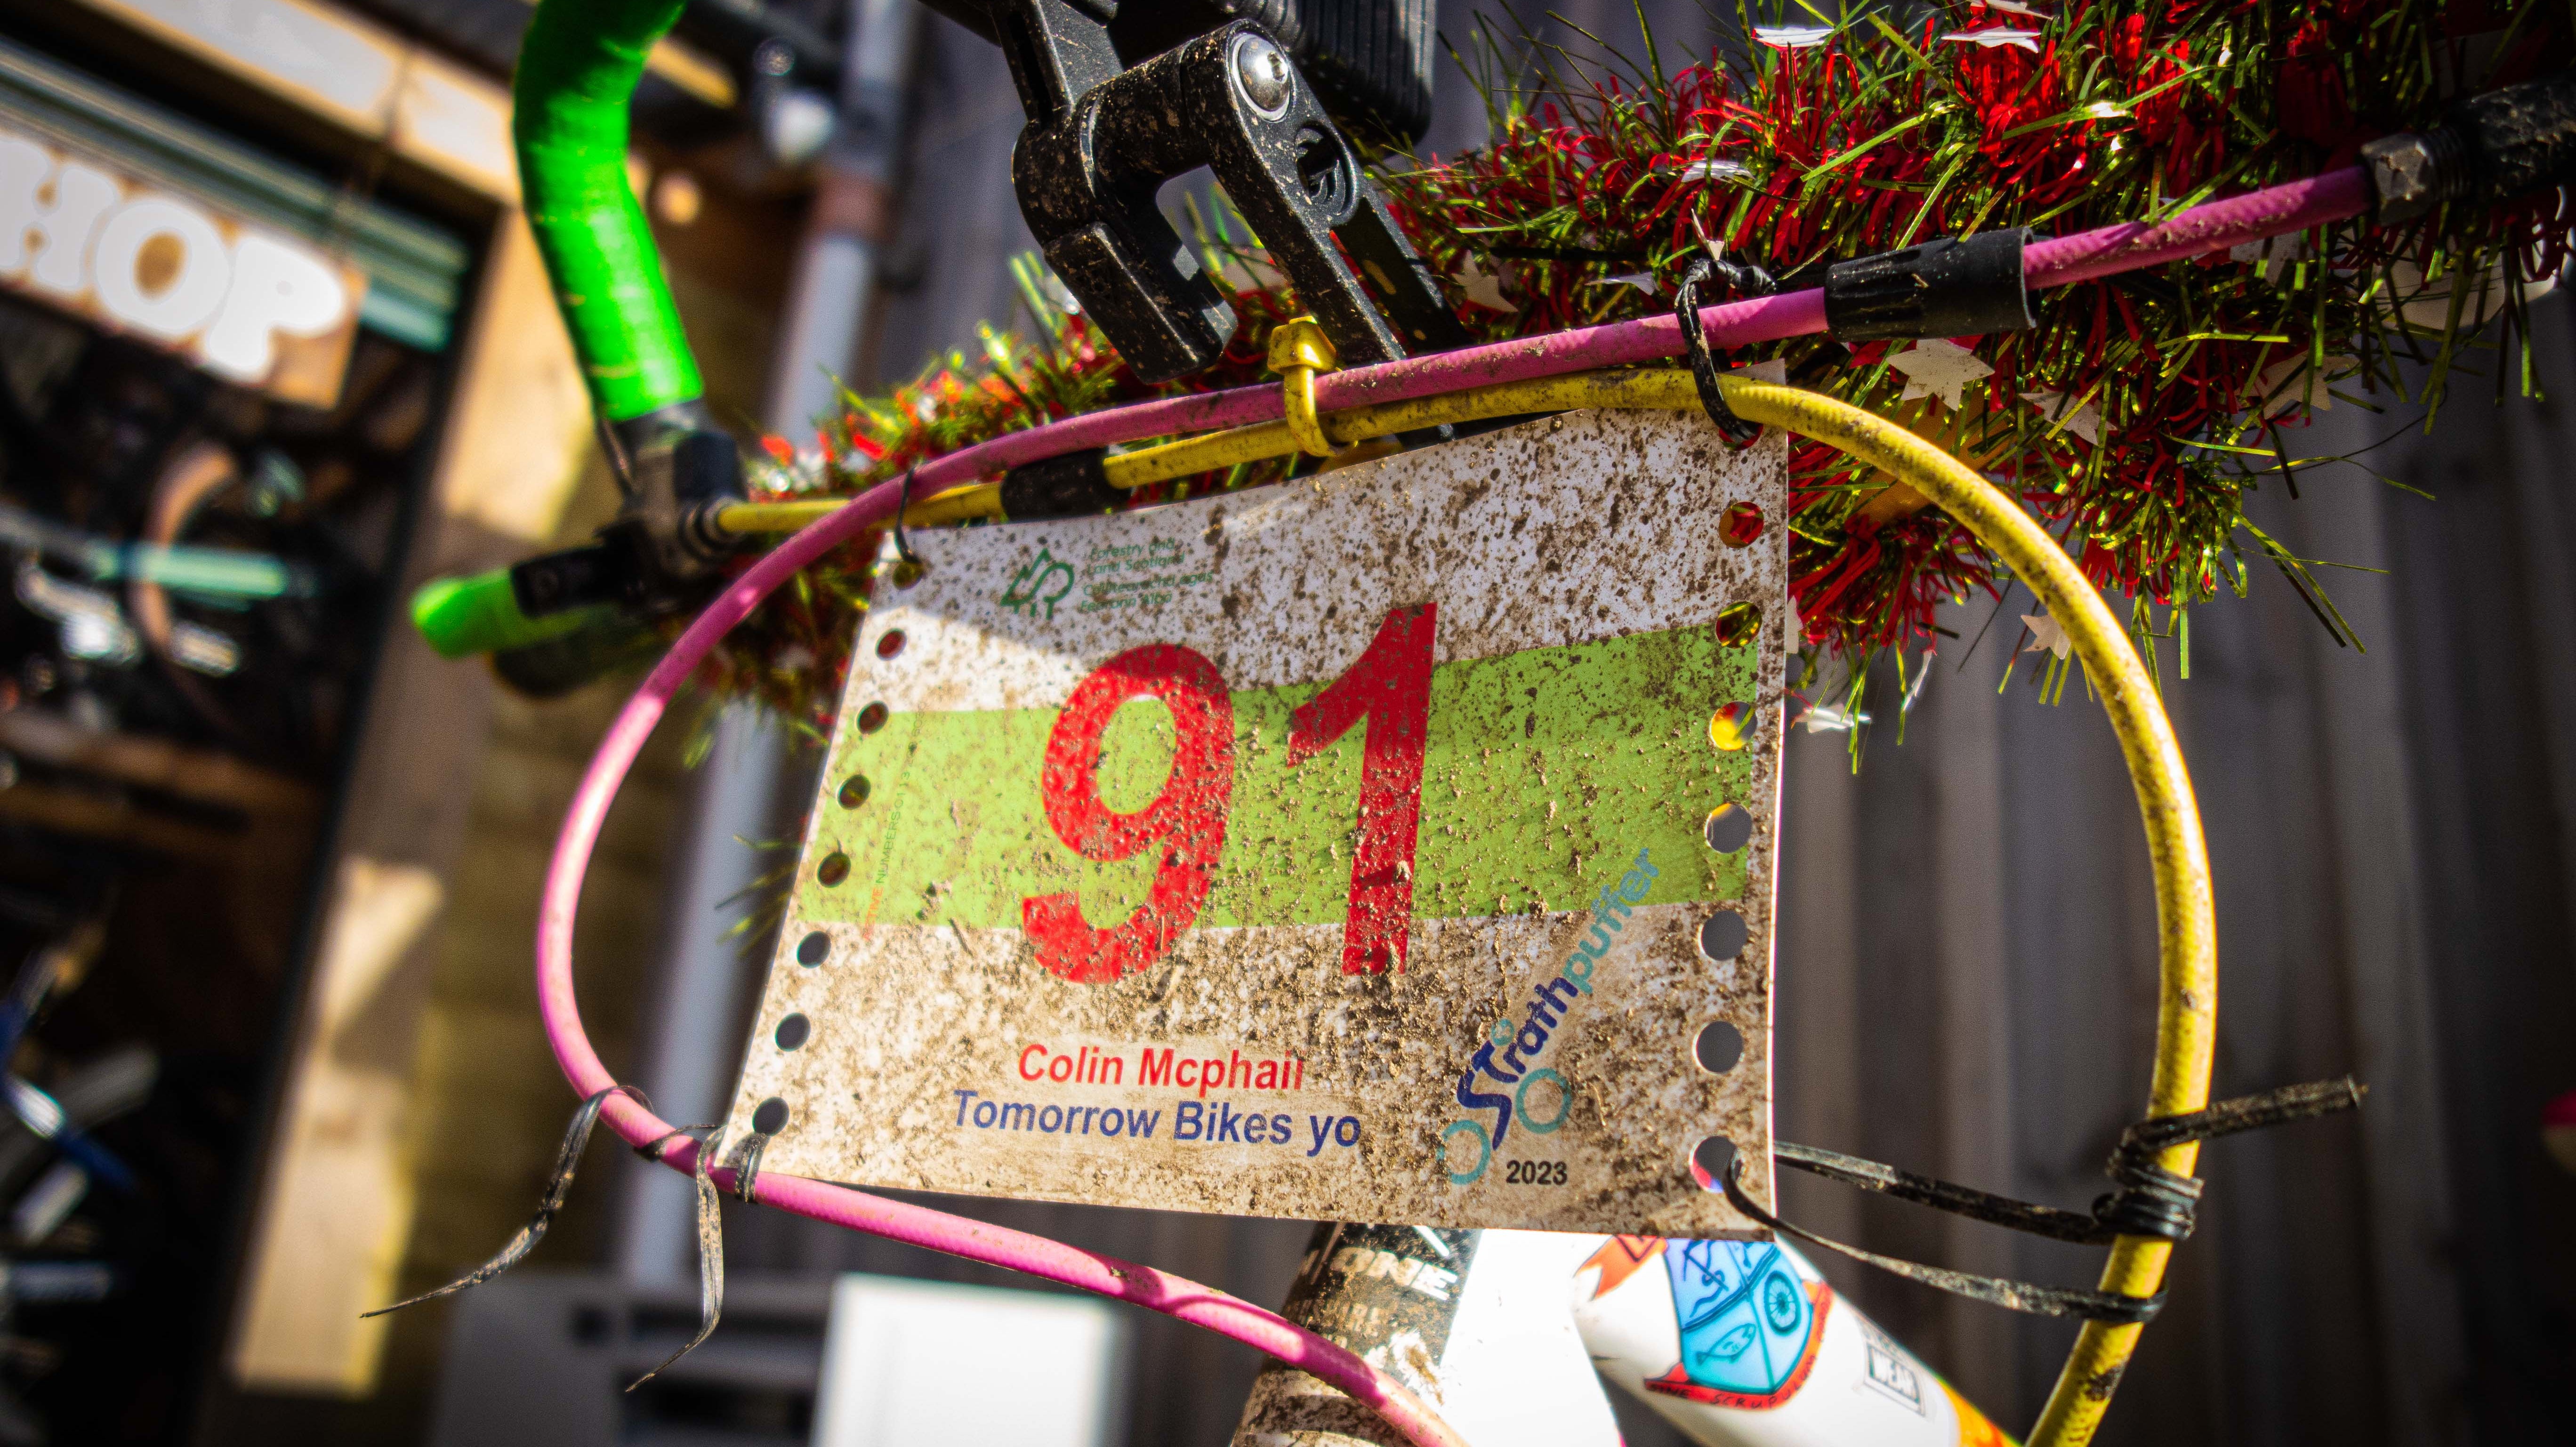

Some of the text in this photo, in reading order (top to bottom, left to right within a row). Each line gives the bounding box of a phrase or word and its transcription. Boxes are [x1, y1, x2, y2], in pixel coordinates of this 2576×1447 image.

[1087, 552, 1185, 576] Land Scotland
[1089, 537, 1175, 561] Forestry and
[1022, 602, 1438, 985] 91
[1018, 1044, 1304, 1098] Colin Mcphail
[953, 1090, 1361, 1158] Tomorrow Bikes yo
[1506, 1159, 1568, 1185] 2023
